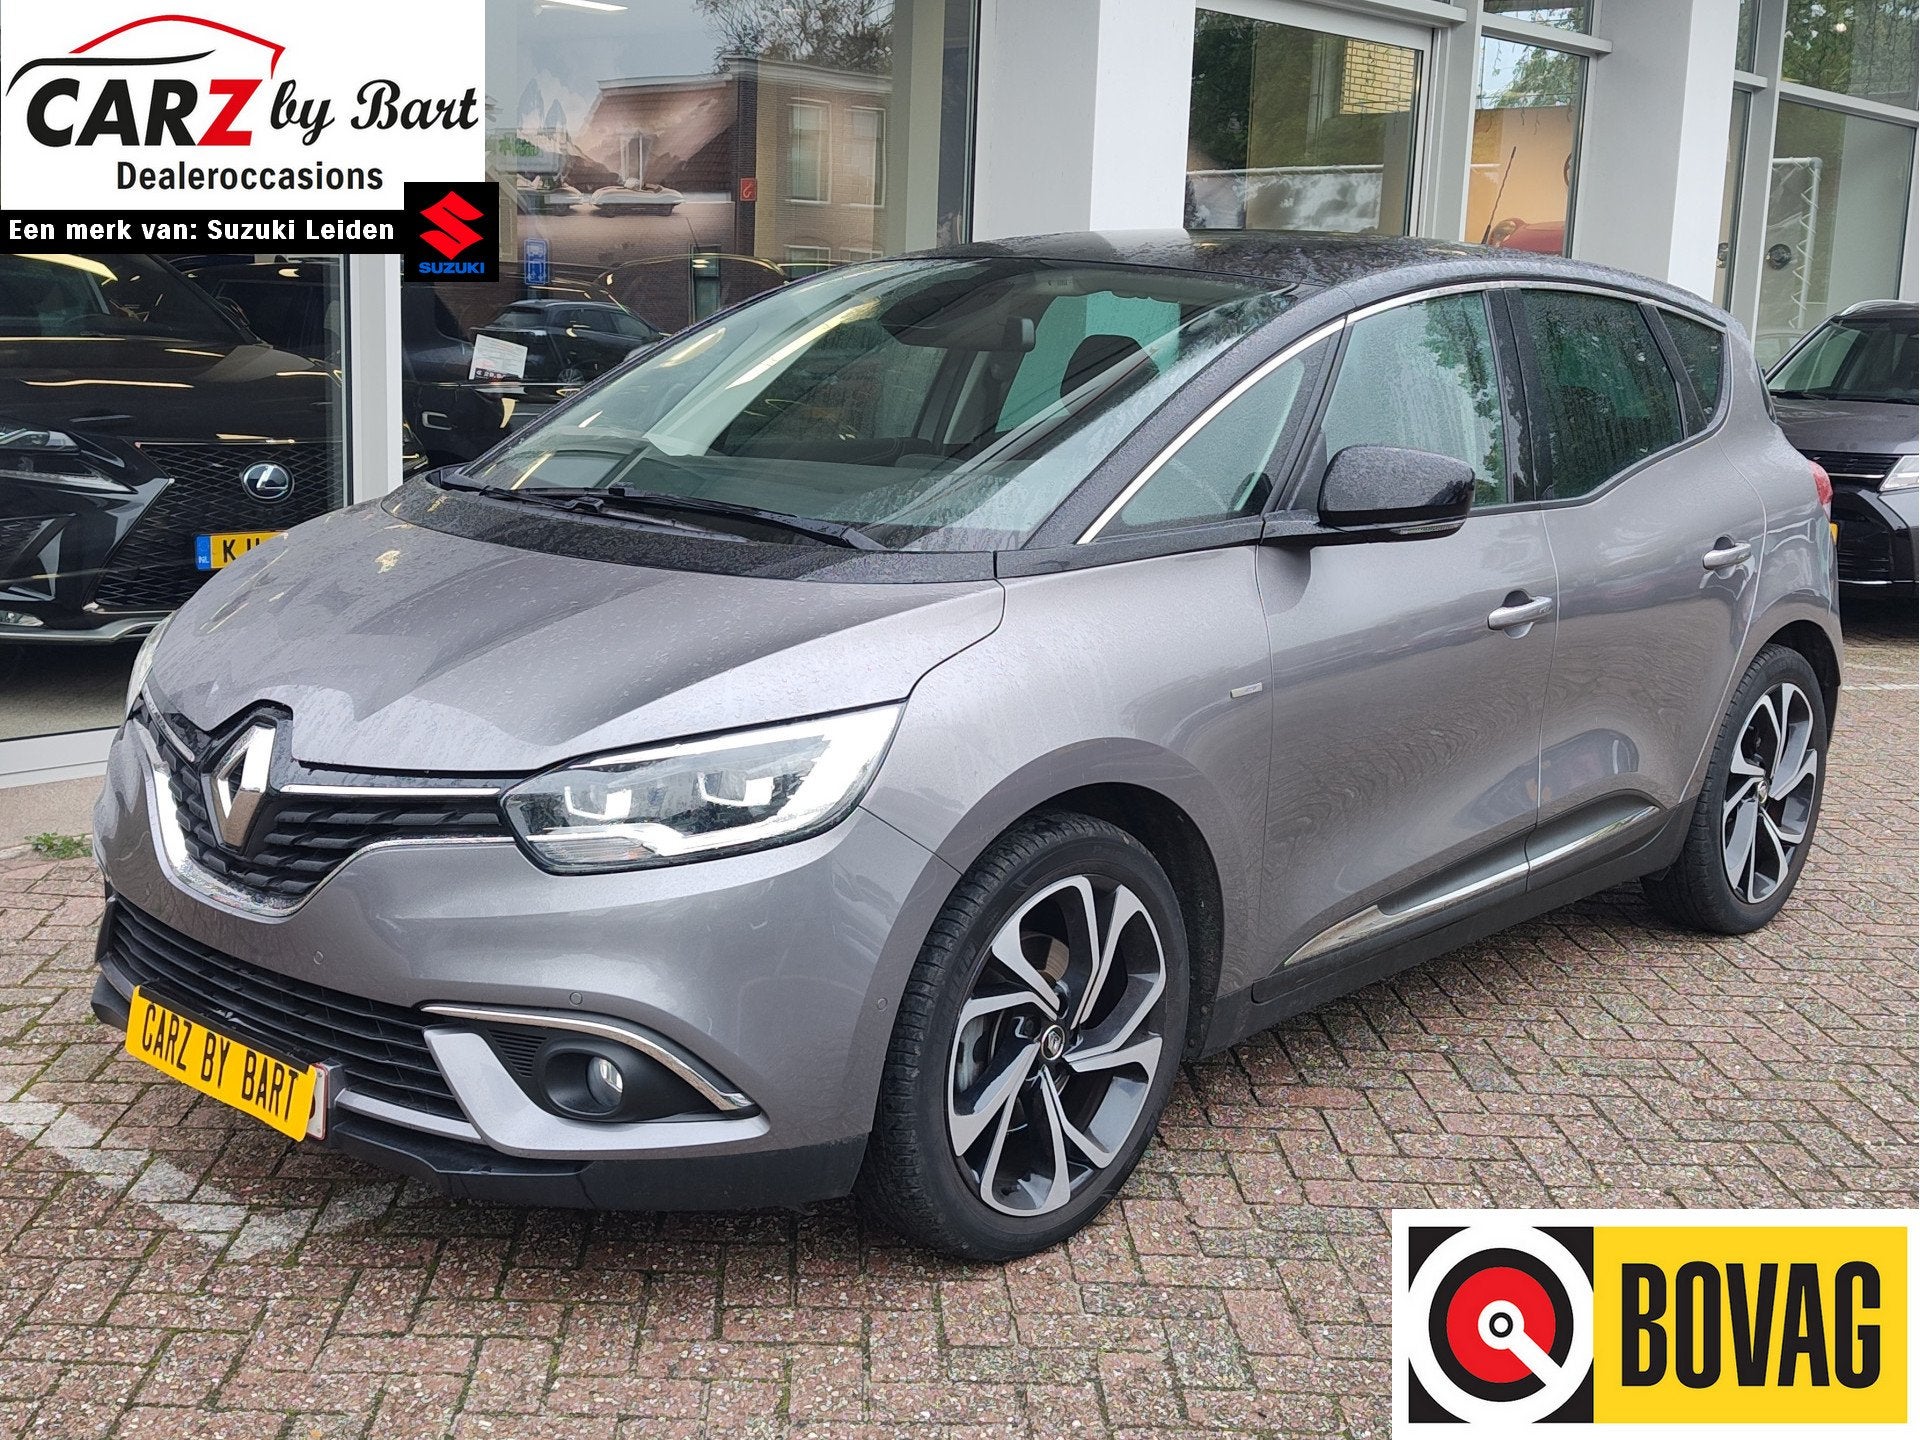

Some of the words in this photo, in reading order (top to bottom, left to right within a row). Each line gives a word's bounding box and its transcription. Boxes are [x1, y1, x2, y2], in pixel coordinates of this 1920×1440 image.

[141, 1003, 193, 1072] CARZ
[200, 1031, 230, 1089] BY
[241, 1049, 298, 1122] BART
